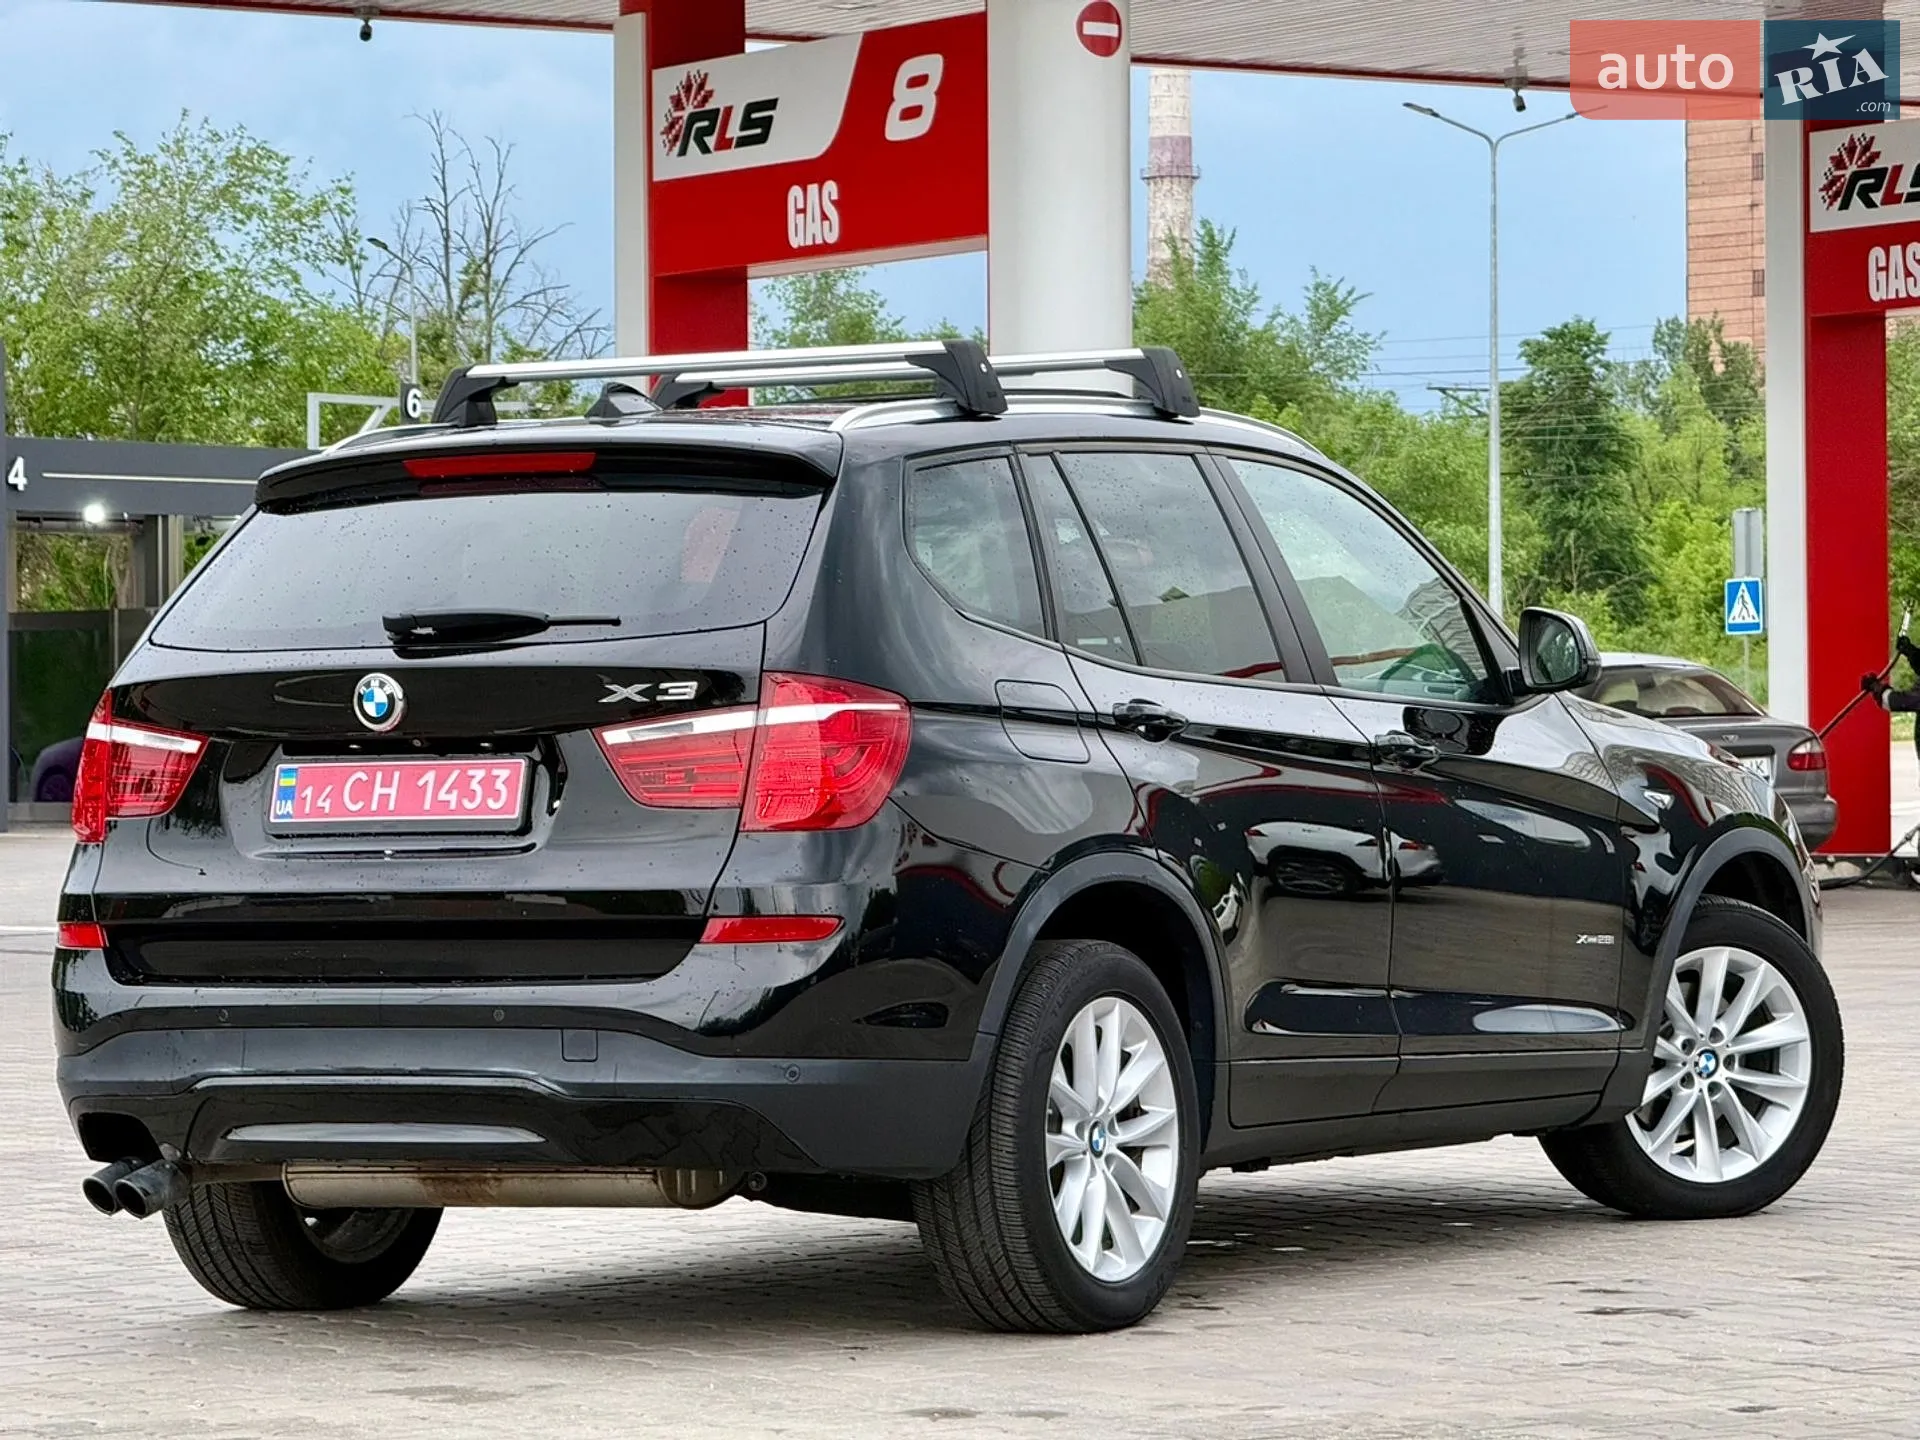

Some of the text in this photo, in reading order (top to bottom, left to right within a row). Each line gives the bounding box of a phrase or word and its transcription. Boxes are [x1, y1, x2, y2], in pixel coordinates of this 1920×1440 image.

[884, 53, 944, 142] 8
[676, 97, 779, 158] RLS
[787, 179, 840, 250] GAS
[406, 387, 422, 419] 6
[7, 455, 28, 491] 4
[598, 681, 698, 702] X3
[275, 800, 293, 815] UA
[300, 768, 512, 814] 14 CH 1433
